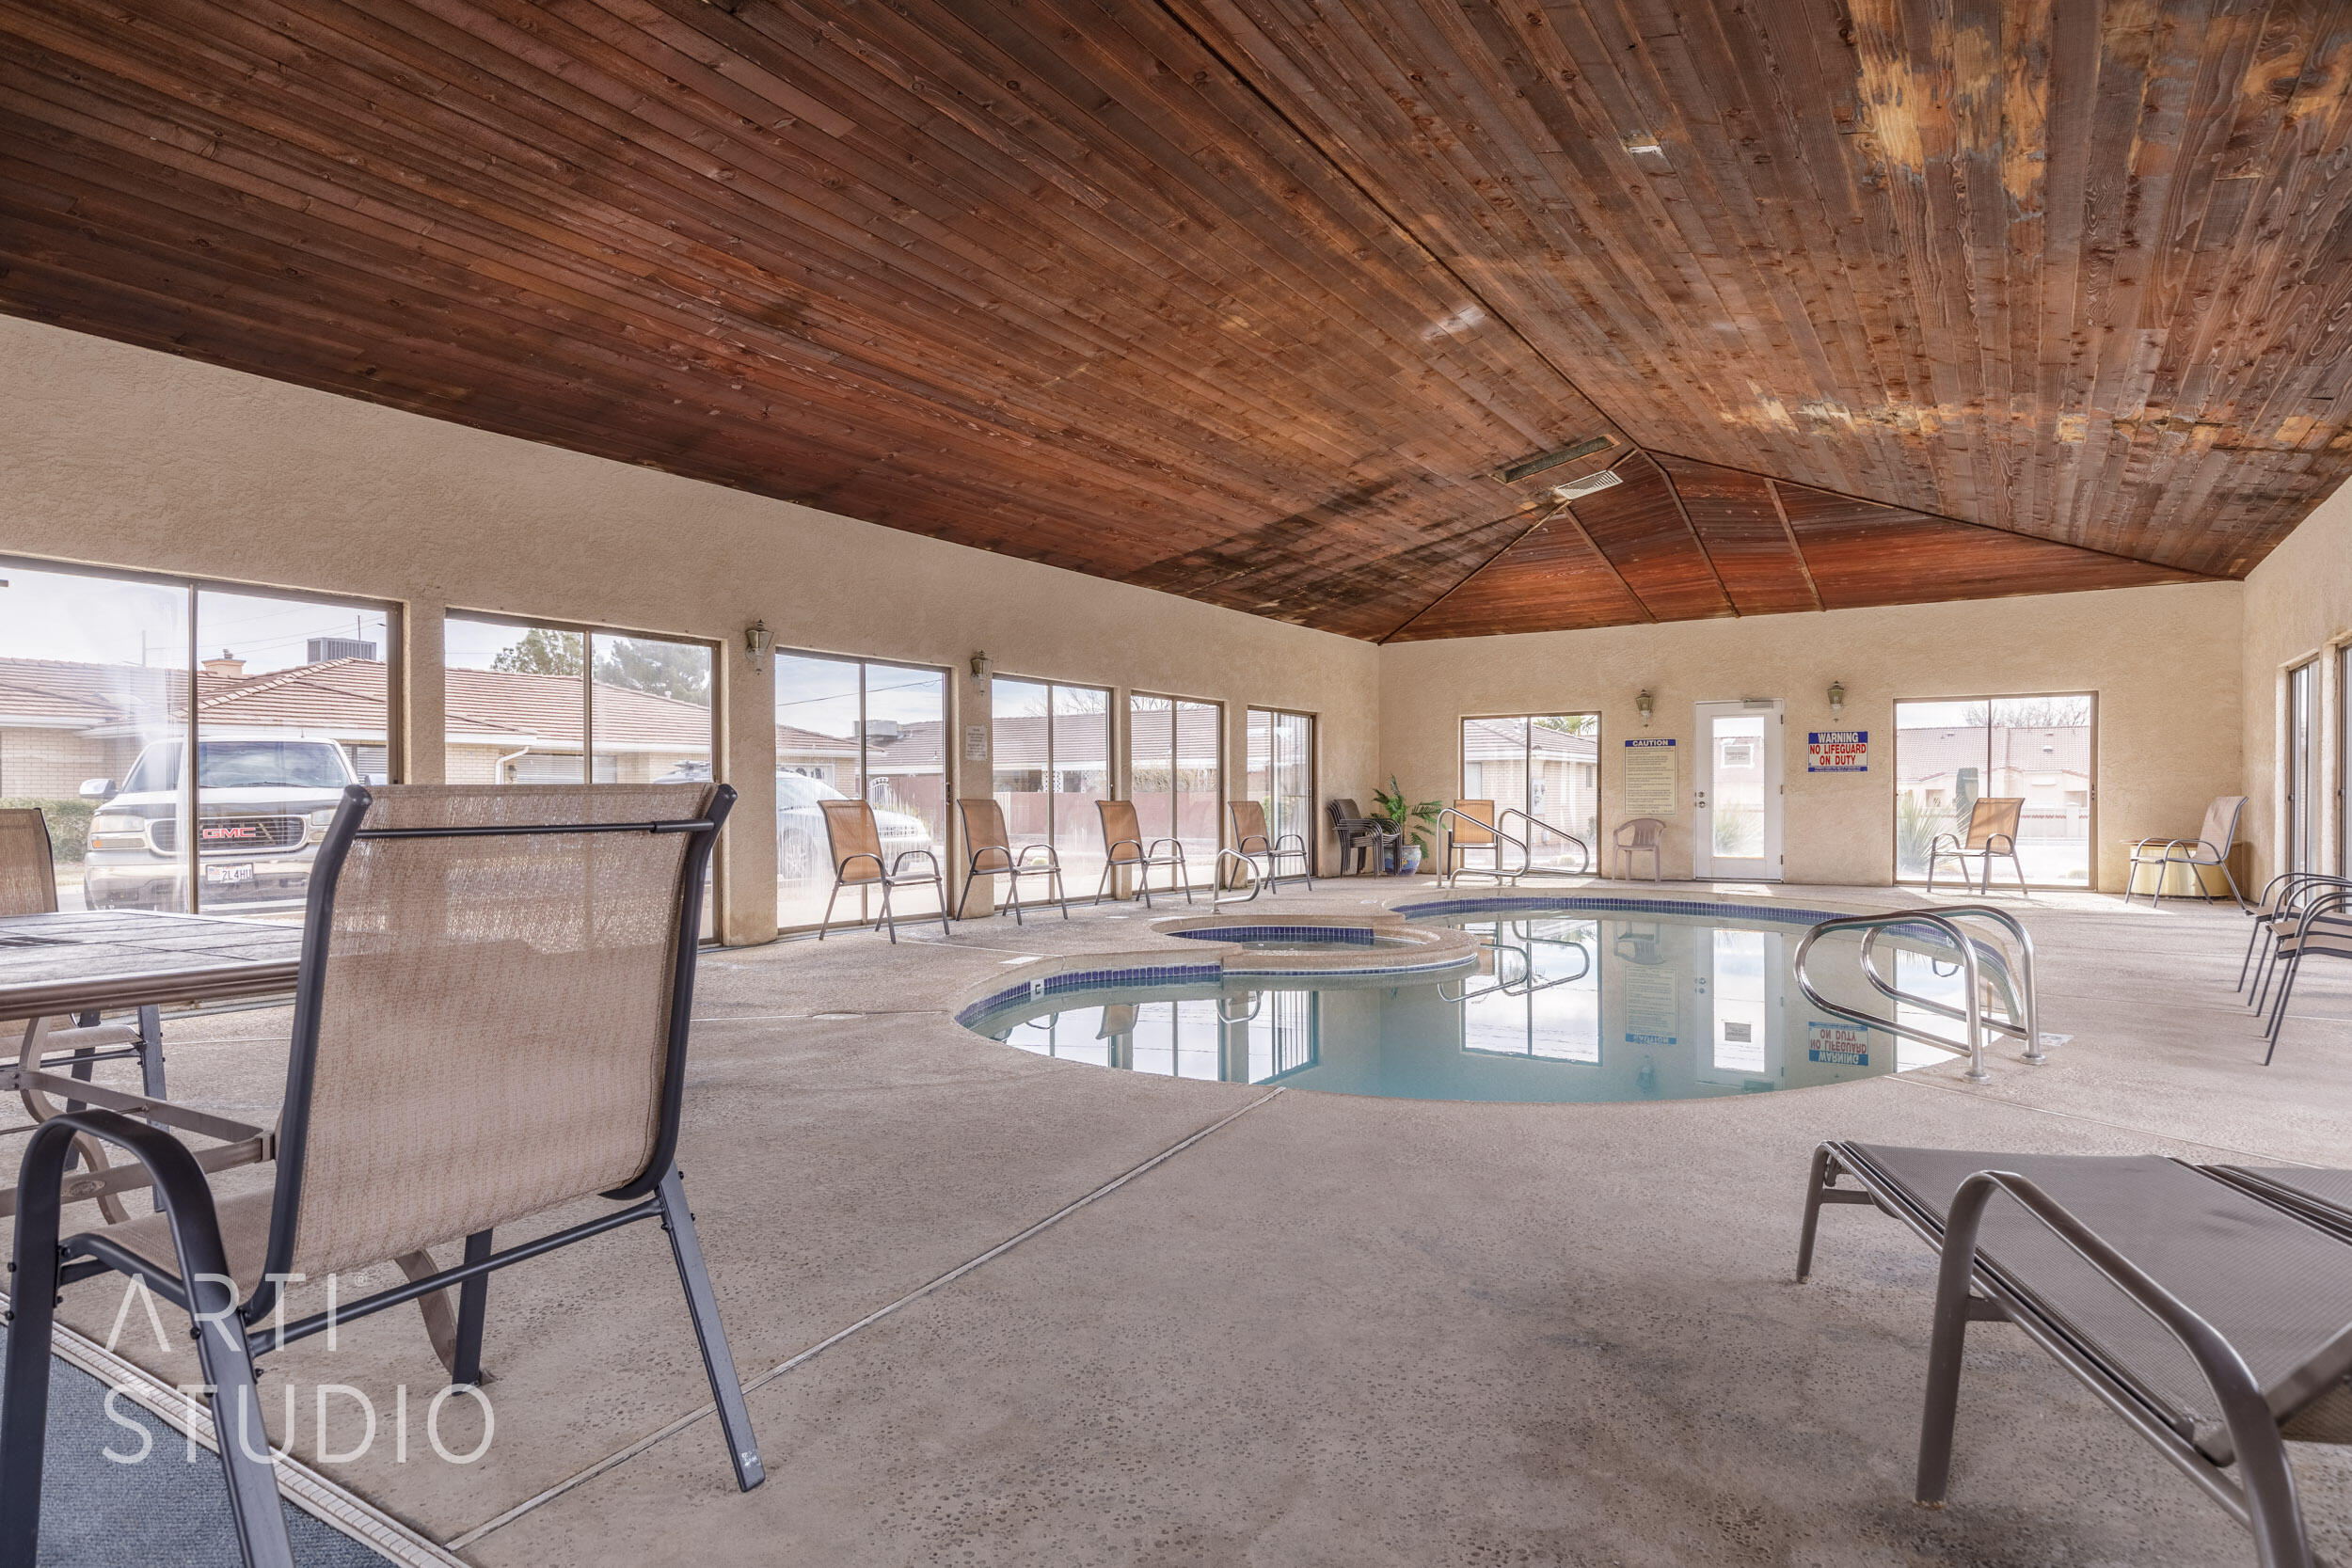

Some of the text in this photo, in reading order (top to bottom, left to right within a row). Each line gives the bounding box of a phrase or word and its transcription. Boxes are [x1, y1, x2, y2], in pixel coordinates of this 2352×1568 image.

[1818, 732, 1859, 743] WARNING
[1809, 743, 1867, 754] NO LIFEGUARD
[1820, 754, 1856, 766] ON DUTY
[202, 827, 257, 840] GMC
